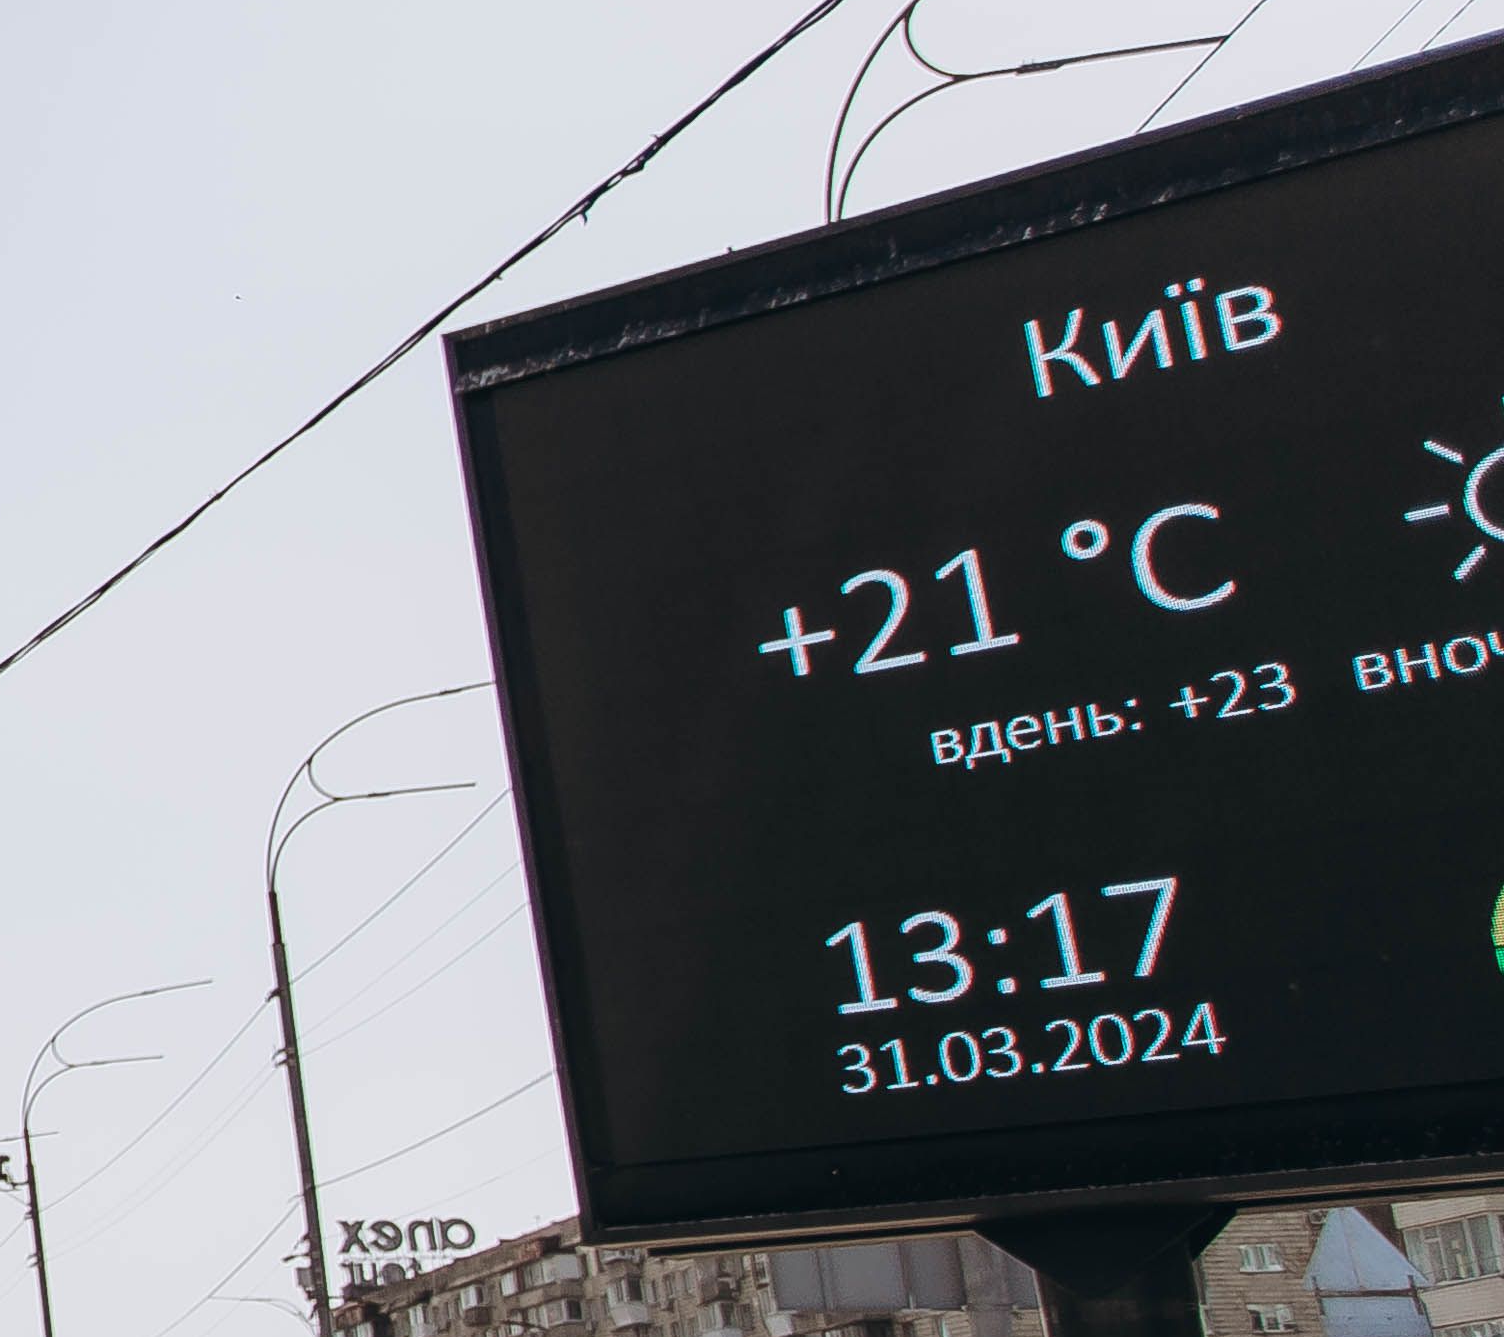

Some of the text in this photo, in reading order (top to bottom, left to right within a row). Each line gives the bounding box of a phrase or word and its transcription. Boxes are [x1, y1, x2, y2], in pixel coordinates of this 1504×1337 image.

[1023, 277, 1284, 398] Київ
[758, 548, 1020, 678] +21
[930, 689, 1144, 769] вдень:
[1168, 663, 1296, 724] +23
[825, 876, 1179, 1016] 13:17
[836, 1001, 1227, 1095] 31.03.2024
